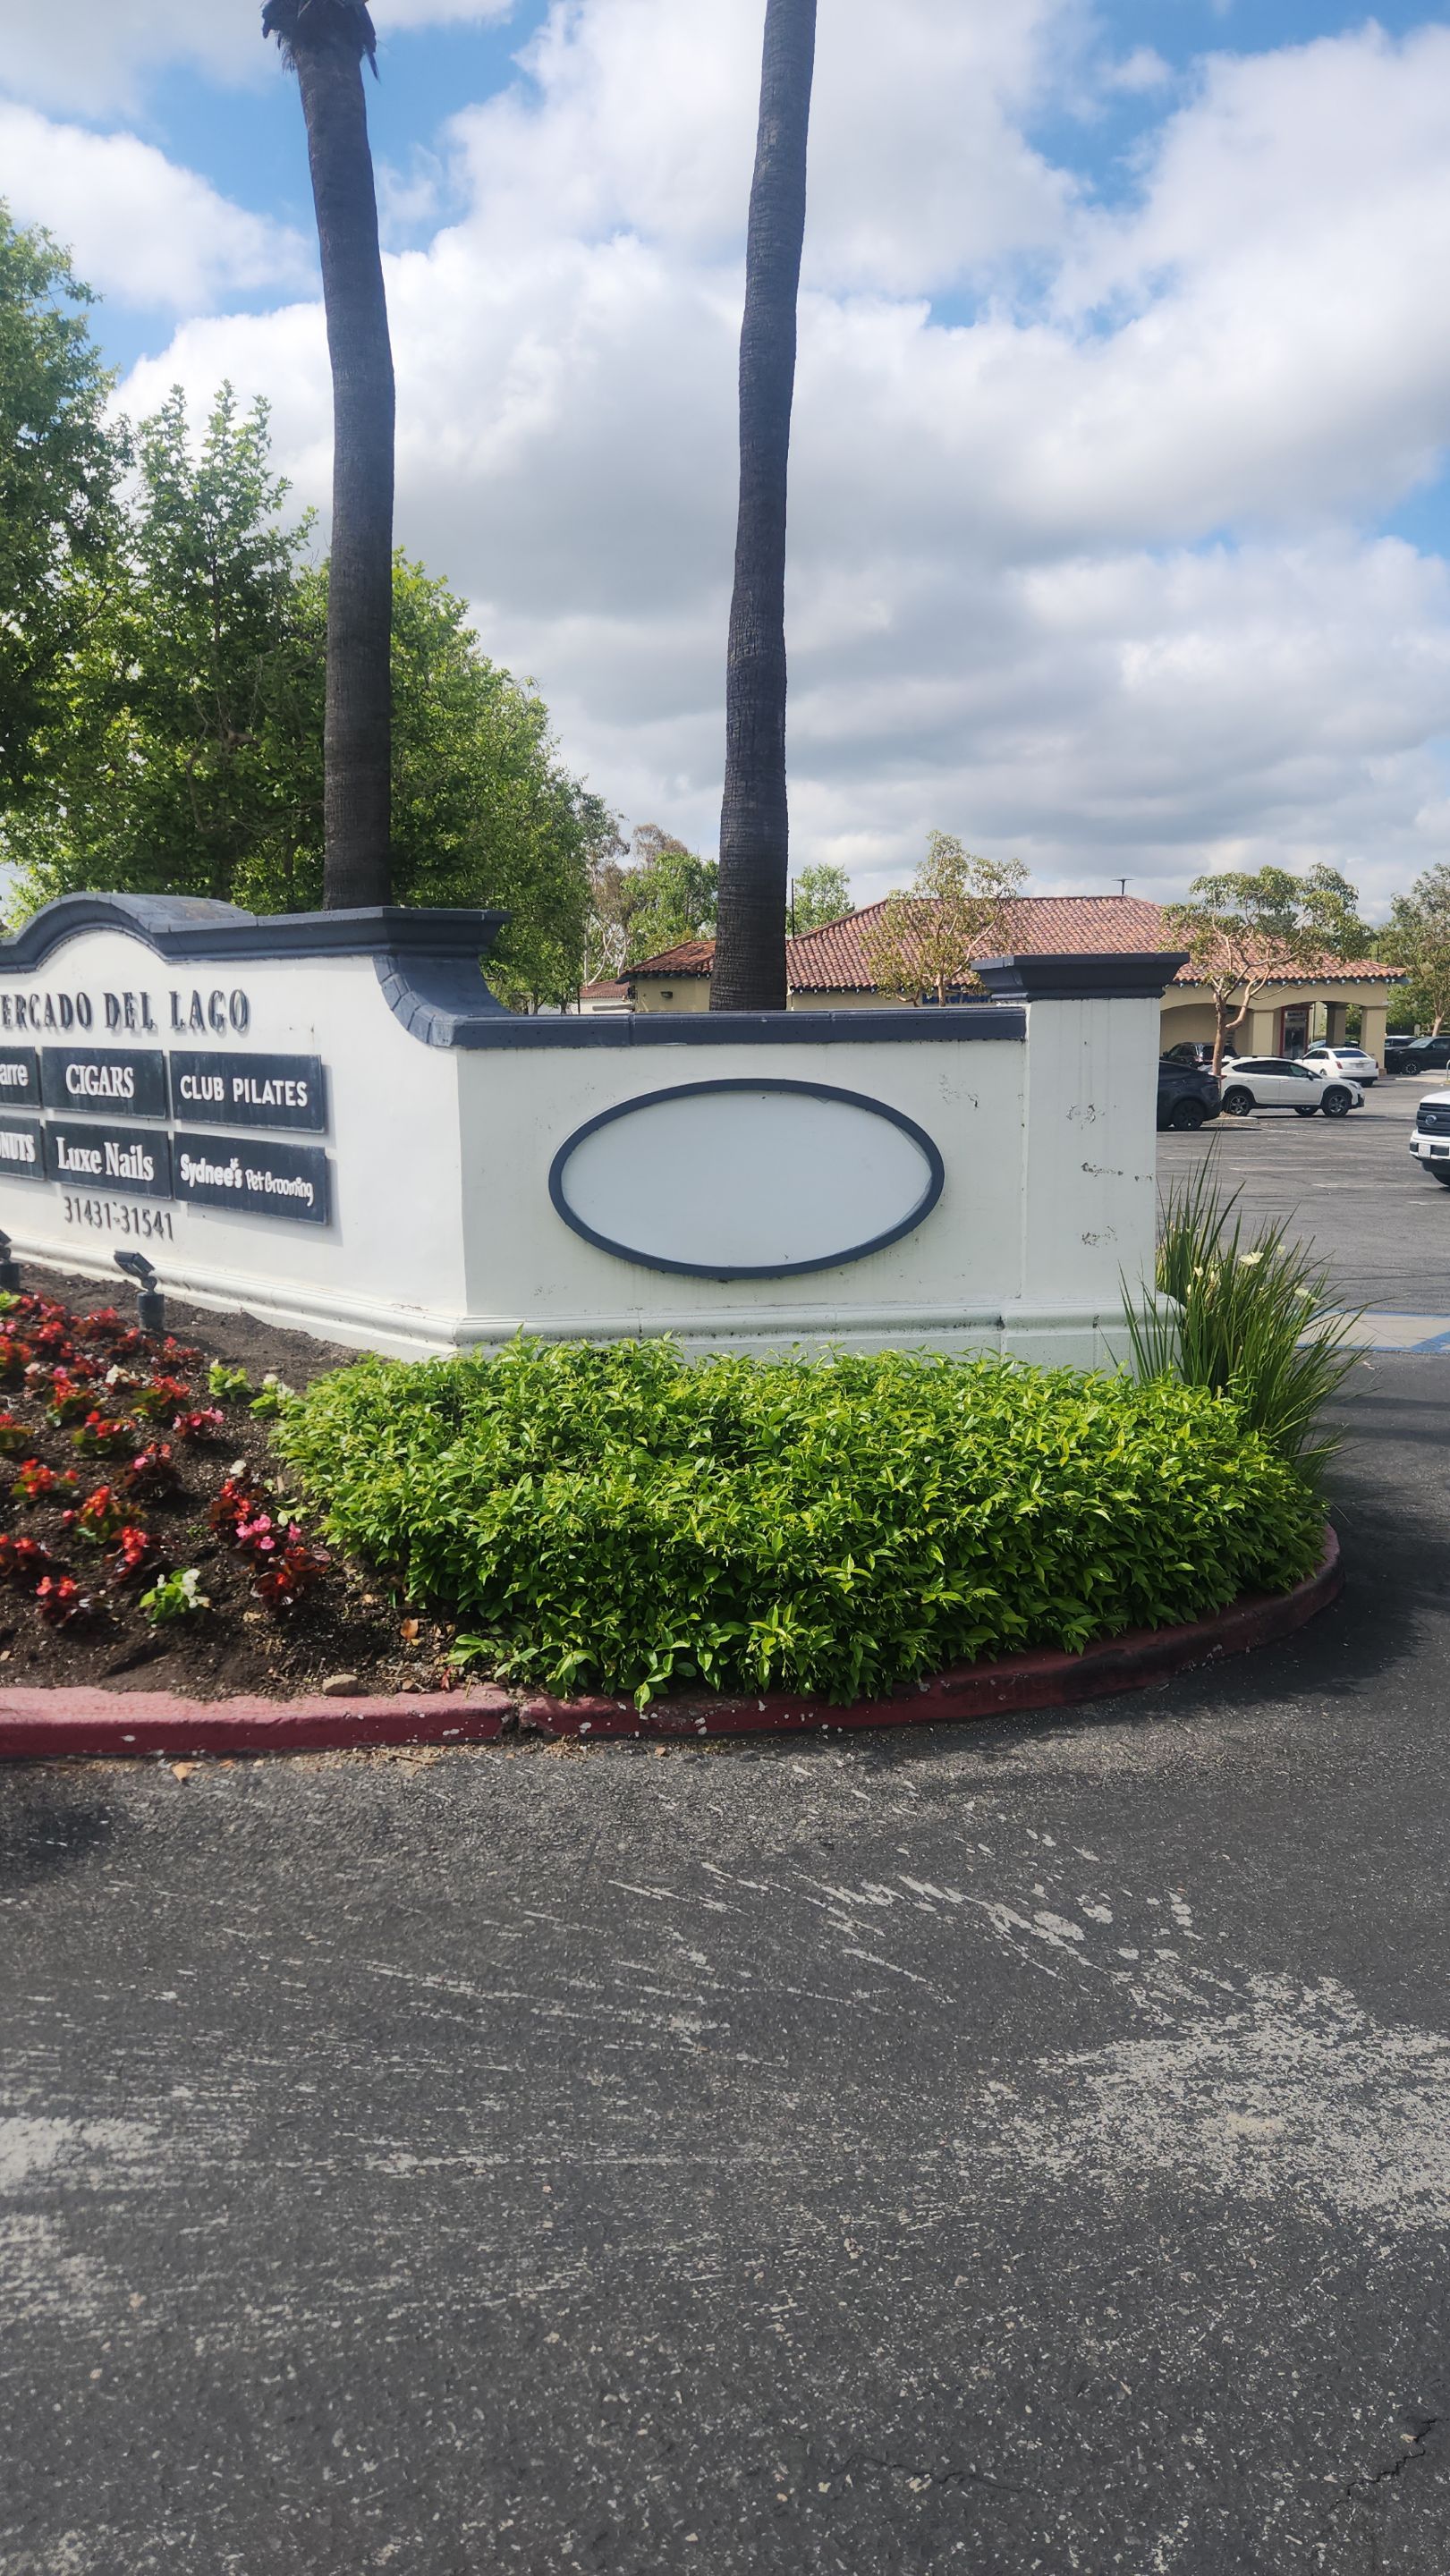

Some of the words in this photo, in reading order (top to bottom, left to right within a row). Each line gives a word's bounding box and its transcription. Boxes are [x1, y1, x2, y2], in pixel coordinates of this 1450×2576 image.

[103, 991, 156, 1030] DEL
[169, 988, 248, 1031] LAGO
[65, 1063, 134, 1098] CIGARS
[180, 1075, 225, 1101] CLUB
[232, 1078, 308, 1107] PILATES
[0, 1131, 36, 1163] NUTS
[55, 1136, 102, 1174] Luxe
[104, 1141, 155, 1182] Nails
[245, 1168, 264, 1191] Pet
[264, 1171, 314, 1207] Grooming
[64, 1196, 174, 1241] 31431-31541
